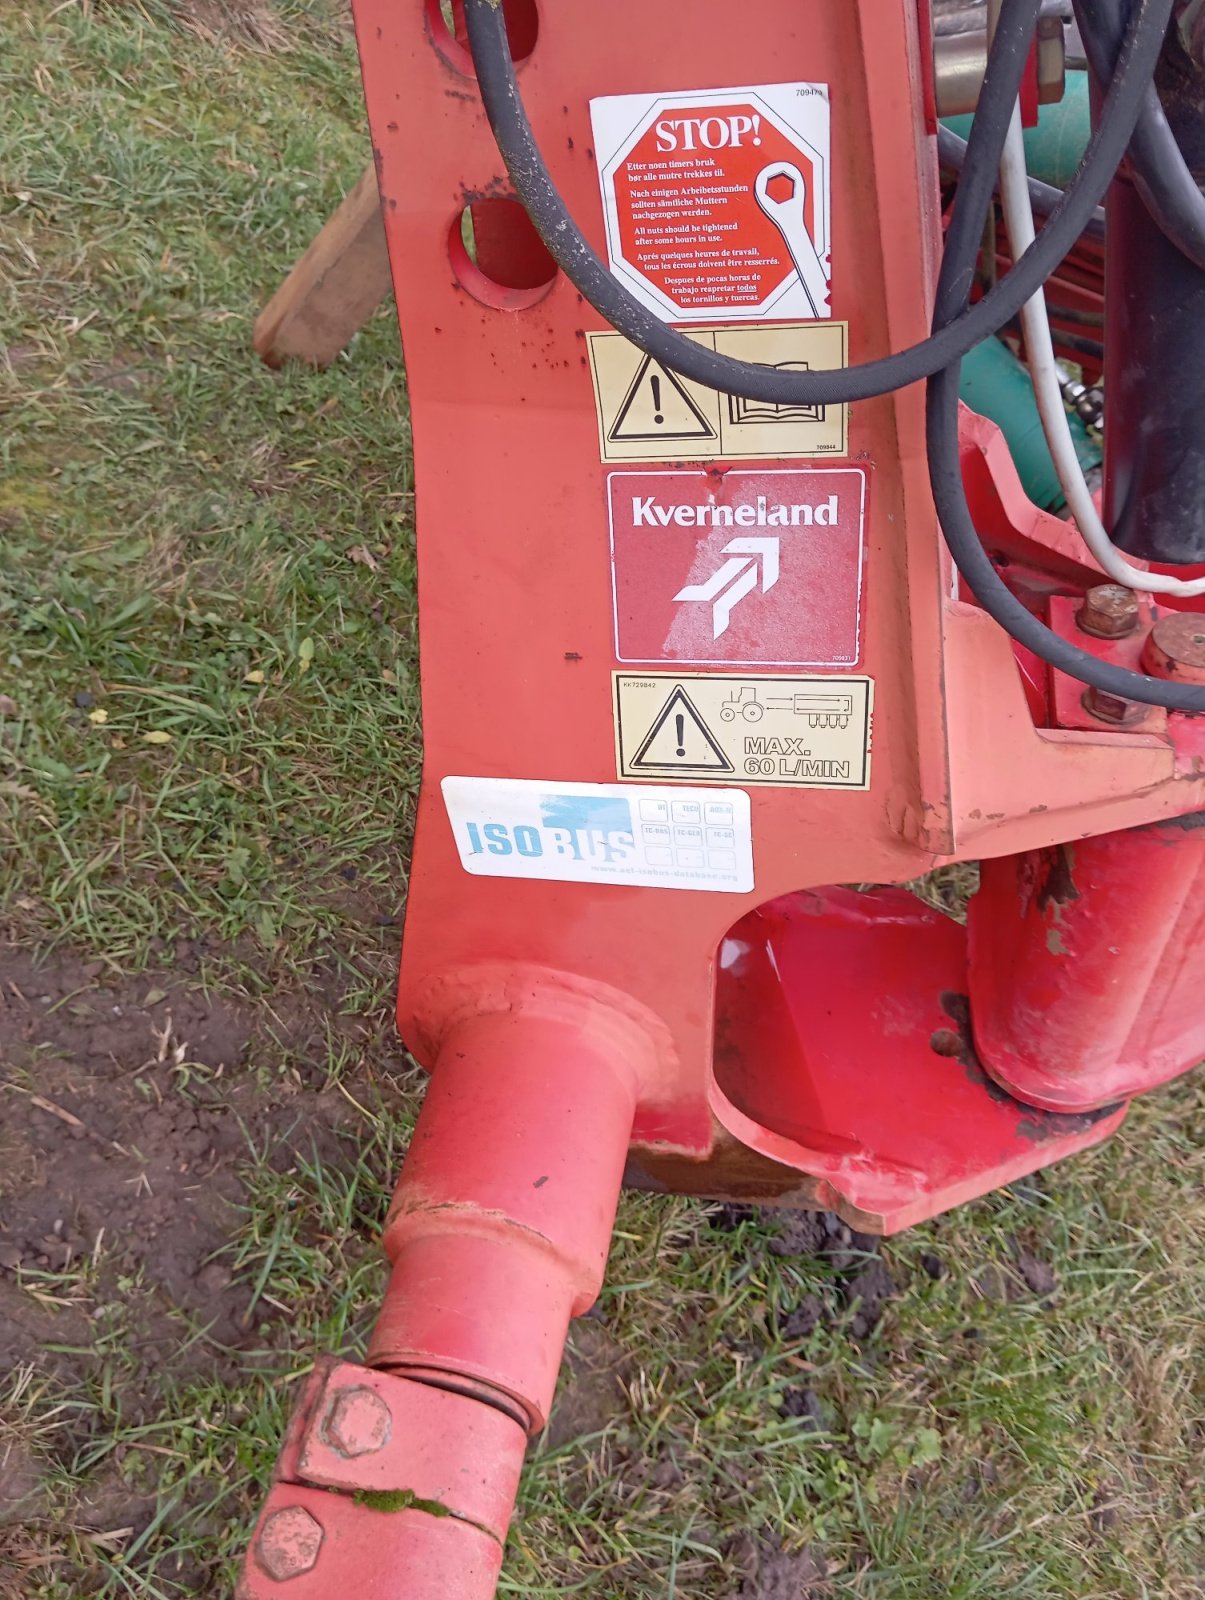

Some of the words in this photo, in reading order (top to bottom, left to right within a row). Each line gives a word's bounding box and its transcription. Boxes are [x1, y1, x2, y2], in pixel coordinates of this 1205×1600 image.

[655, 114, 761, 152] STOP!
[627, 162, 647, 171] Etter
[648, 161, 667, 169] noen
[668, 160, 694, 168] timers
[695, 158, 715, 167] bruk
[628, 173, 641, 182] bør
[643, 173, 657, 181] alle
[658, 172, 682, 180] mutre
[684, 170, 713, 179] trekkes
[714, 169, 725, 177] til.
[630, 190, 650, 198] Nach
[651, 189, 678, 197] einigen
[631, 201, 656, 209] sollten
[657, 199, 694, 208] sämtliche
[695, 197, 728, 205] Muttern
[632, 211, 680, 220] nachgezogen
[681, 209, 712, 217] werden.
[634, 227, 646, 235] All
[664, 225, 690, 233] should
[691, 224, 701, 232] be
[702, 222, 738, 232] tightened
[635, 237, 653, 245] after
[675, 236, 696, 244] hours
[660, 251, 693, 261] quelques
[694, 250, 720, 258] heures
[721, 249, 731, 257] de
[731, 248, 760, 256] travail,
[644, 263, 660, 271] tous
[661, 262, 671, 270] les
[672, 261, 697, 269] écrous
[698, 260, 727, 268] doivent
[727, 259, 742, 267] être
[744, 257, 780, 266] resserrés.
[664, 276, 695, 285] Despues
[696, 275, 705, 283] de
[706, 275, 728, 284] pocas
[729, 274, 750, 282] horas
[751, 273, 761, 281] de
[671, 286, 699, 295] trabajo
[700, 285, 736, 294] reapretar
[737, 283, 757, 292] todos
[692, 295, 723, 303] tornillos
[631, 494, 839, 527] Kverneland
[744, 736, 812, 756] MAX.
[744, 757, 776, 776] 60
[779, 759, 850, 779] L/MIN
